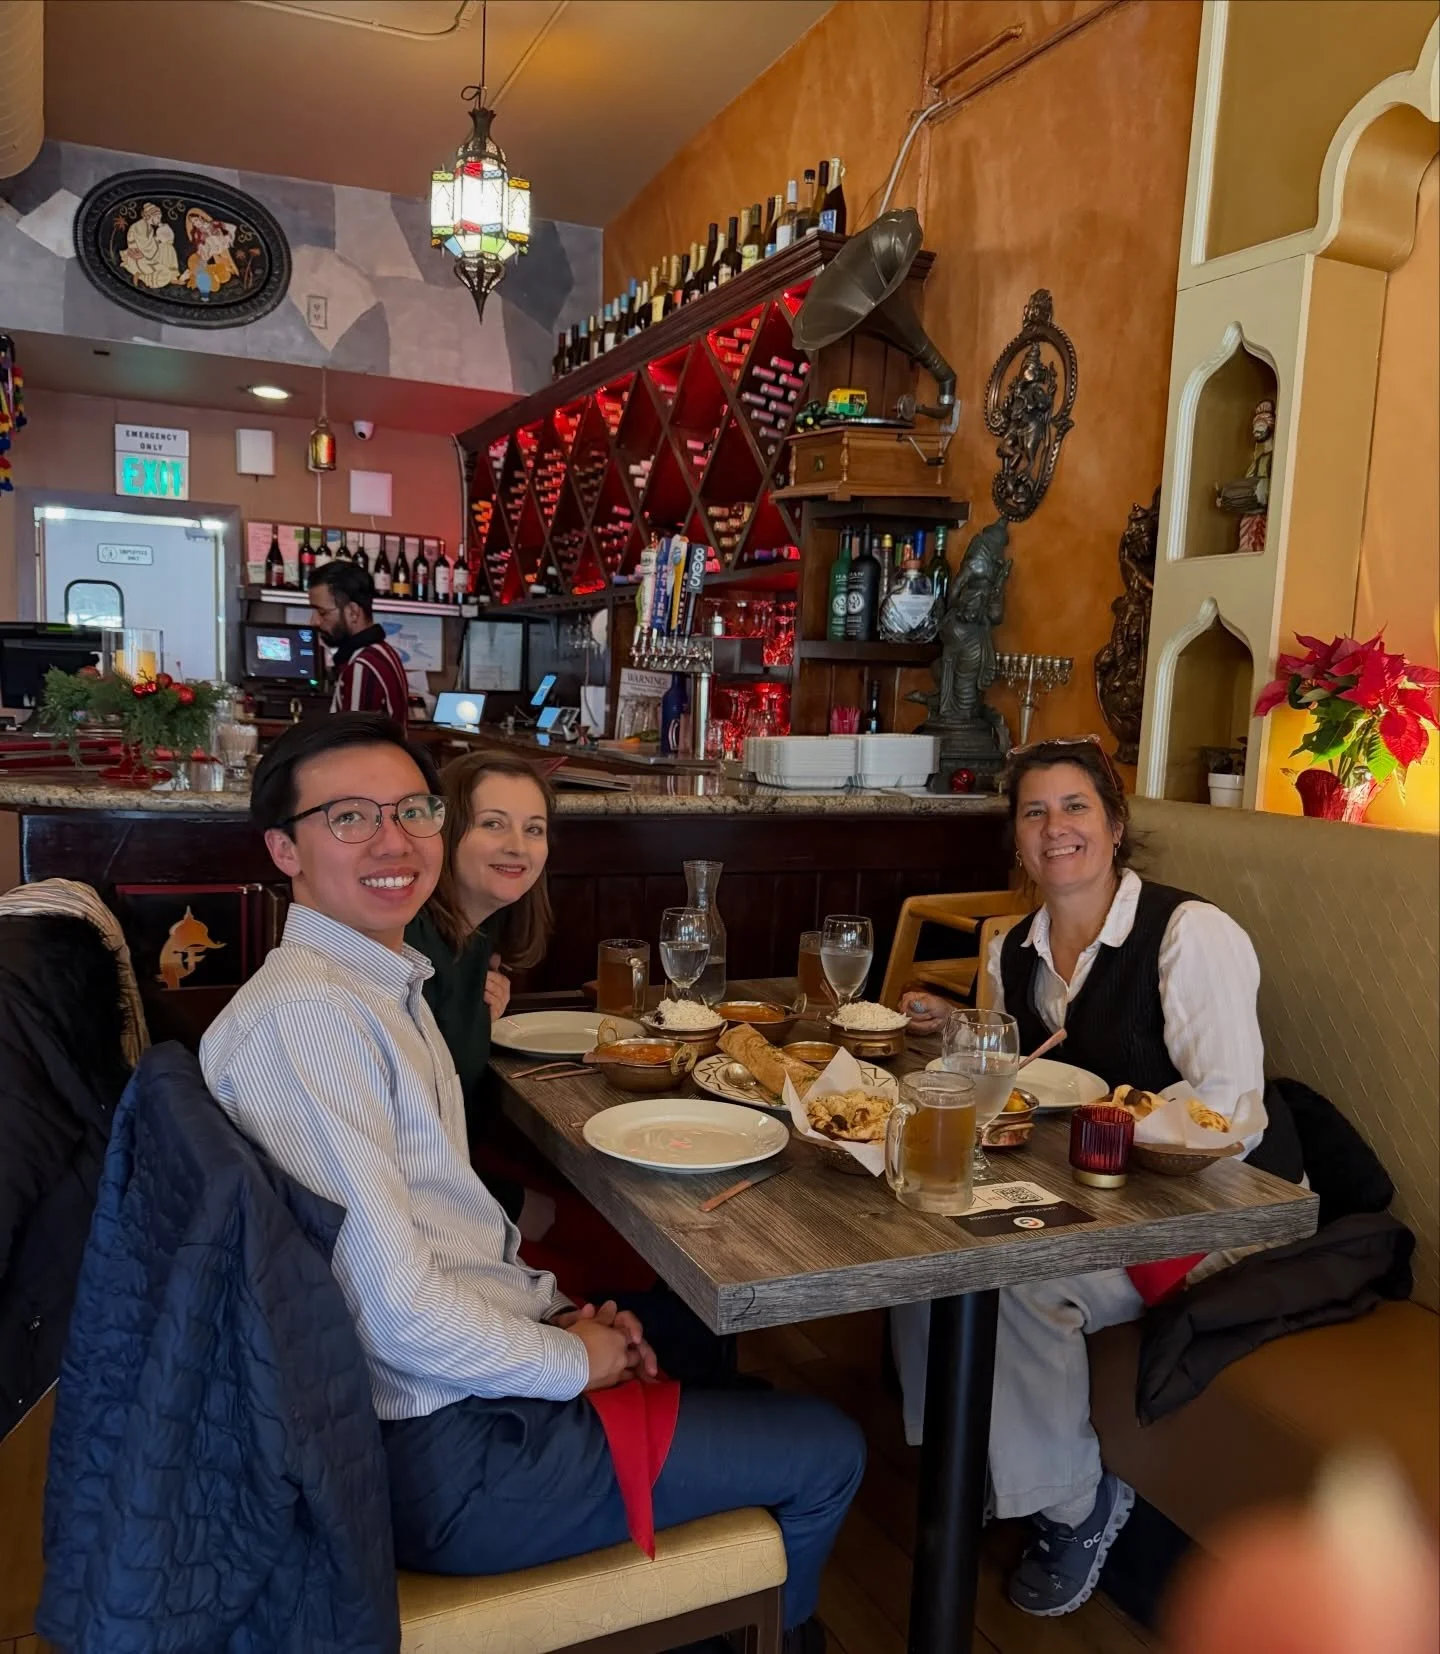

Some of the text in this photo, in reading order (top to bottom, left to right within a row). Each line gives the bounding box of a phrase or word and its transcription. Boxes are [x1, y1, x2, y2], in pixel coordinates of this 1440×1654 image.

[125, 429, 177, 441] EMERGENCY
[140, 442, 163, 451] ONLY
[122, 456, 182, 497] EXIT
[732, 1286, 761, 1321] 2
